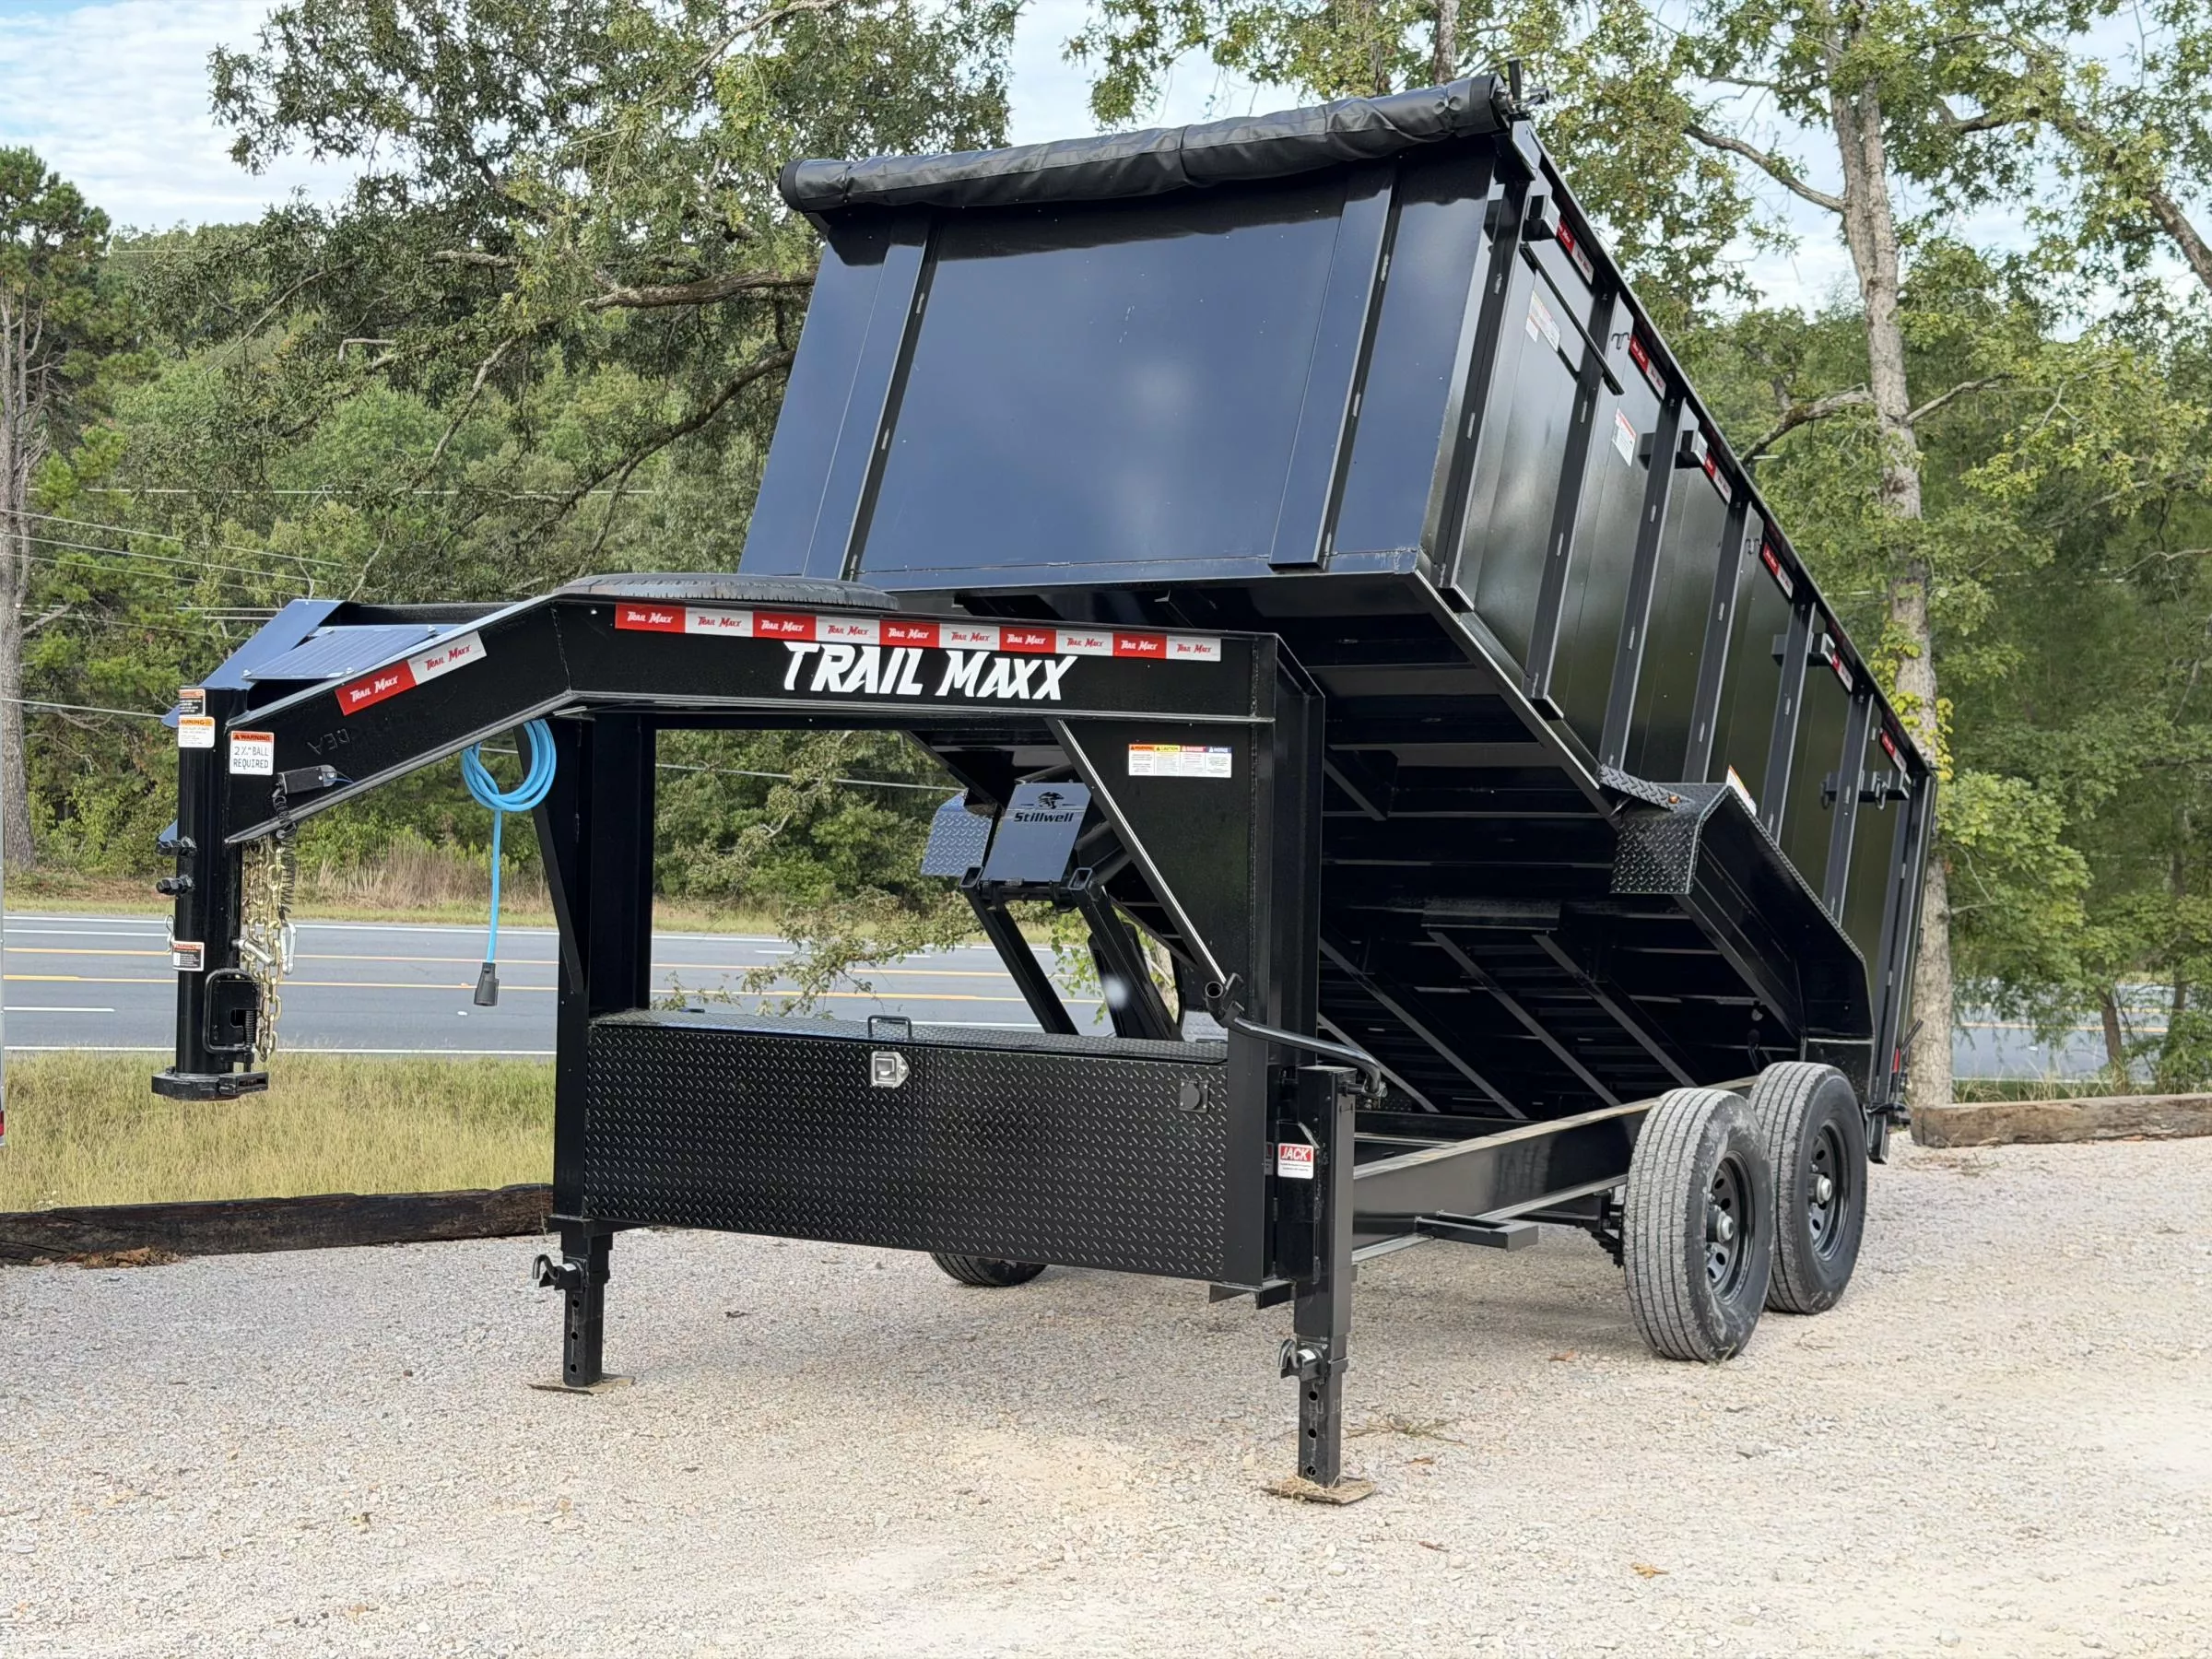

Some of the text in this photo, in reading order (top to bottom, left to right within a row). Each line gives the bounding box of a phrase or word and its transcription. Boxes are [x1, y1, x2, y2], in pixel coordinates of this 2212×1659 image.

[783, 641, 1078, 700] TRAIL MAXX
[253, 746, 269, 756] BALL
[233, 758, 269, 770] REQUIRED
[1014, 812, 1074, 823] Stillwell
[1282, 1147, 1310, 1161] JACK
